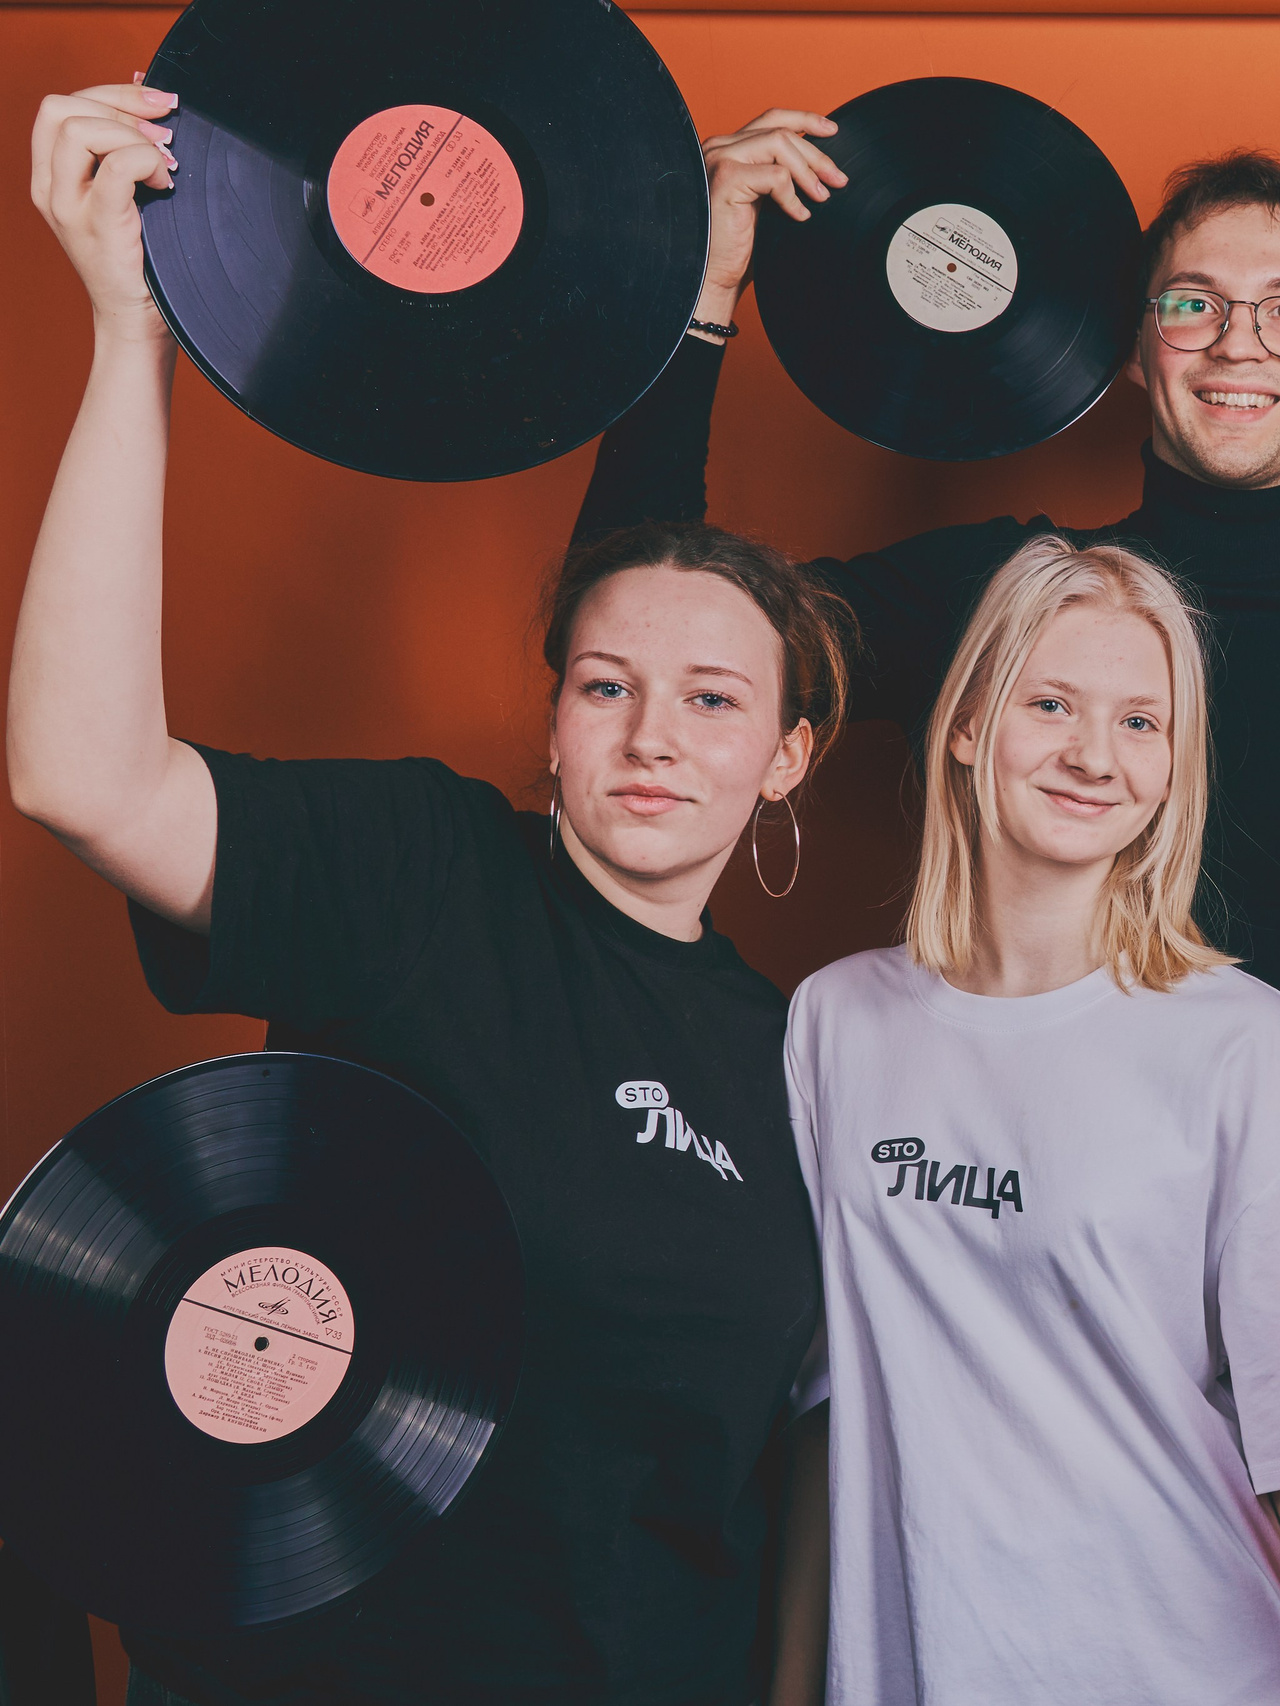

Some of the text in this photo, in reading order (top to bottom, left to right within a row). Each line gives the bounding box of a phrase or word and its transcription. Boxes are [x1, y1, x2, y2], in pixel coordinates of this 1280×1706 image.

[355, 131, 382, 168] МИНИСТЕРСТВО
[360, 134, 388, 172] КУЛЬТУРЫ СССР
[368, 125, 406, 178] ВСЕСОЮЗНАЯ ФИРМА
[452, 130, 463, 141] 33
[374, 119, 436, 201] МЕЛОДИЯ
[374, 141, 404, 181] ГРАМПЛАСТИНОК
[398, 172, 417, 195] ОРДЕНА
[414, 149, 433, 173] ЛЕНИНА
[430, 129, 446, 149] ЗАВОД
[377, 226, 398, 252] СТЕРЕО
[419, 231, 430, 245] АЛЛА
[428, 206, 447, 231] ПУГАЧЕВА
[388, 248, 399, 261] ГОСТ
[947, 233, 1002, 272] МЕЛОДИЯ
[625, 1088, 663, 1103] STO
[636, 1106, 744, 1182] ЛИЦА
[878, 1142, 917, 1158] STO
[887, 1159, 1024, 1219] ЛИЦА
[221, 1257, 344, 1317] МИНИСТЕРСТВО КУЛЬТУРЫ СССР
[223, 1264, 337, 1324] МЕЛОДИЯ
[231, 1282, 321, 1325] ВСЕСОЮЗНАЯ ФИРМА ГРАМПЛАСТИНОК
[222, 1304, 319, 1339] АПРЕЛЕВСКИЙ ОРДЕНА ЛЕНИНА ЗАВОД
[331, 1329, 343, 1340] 33
